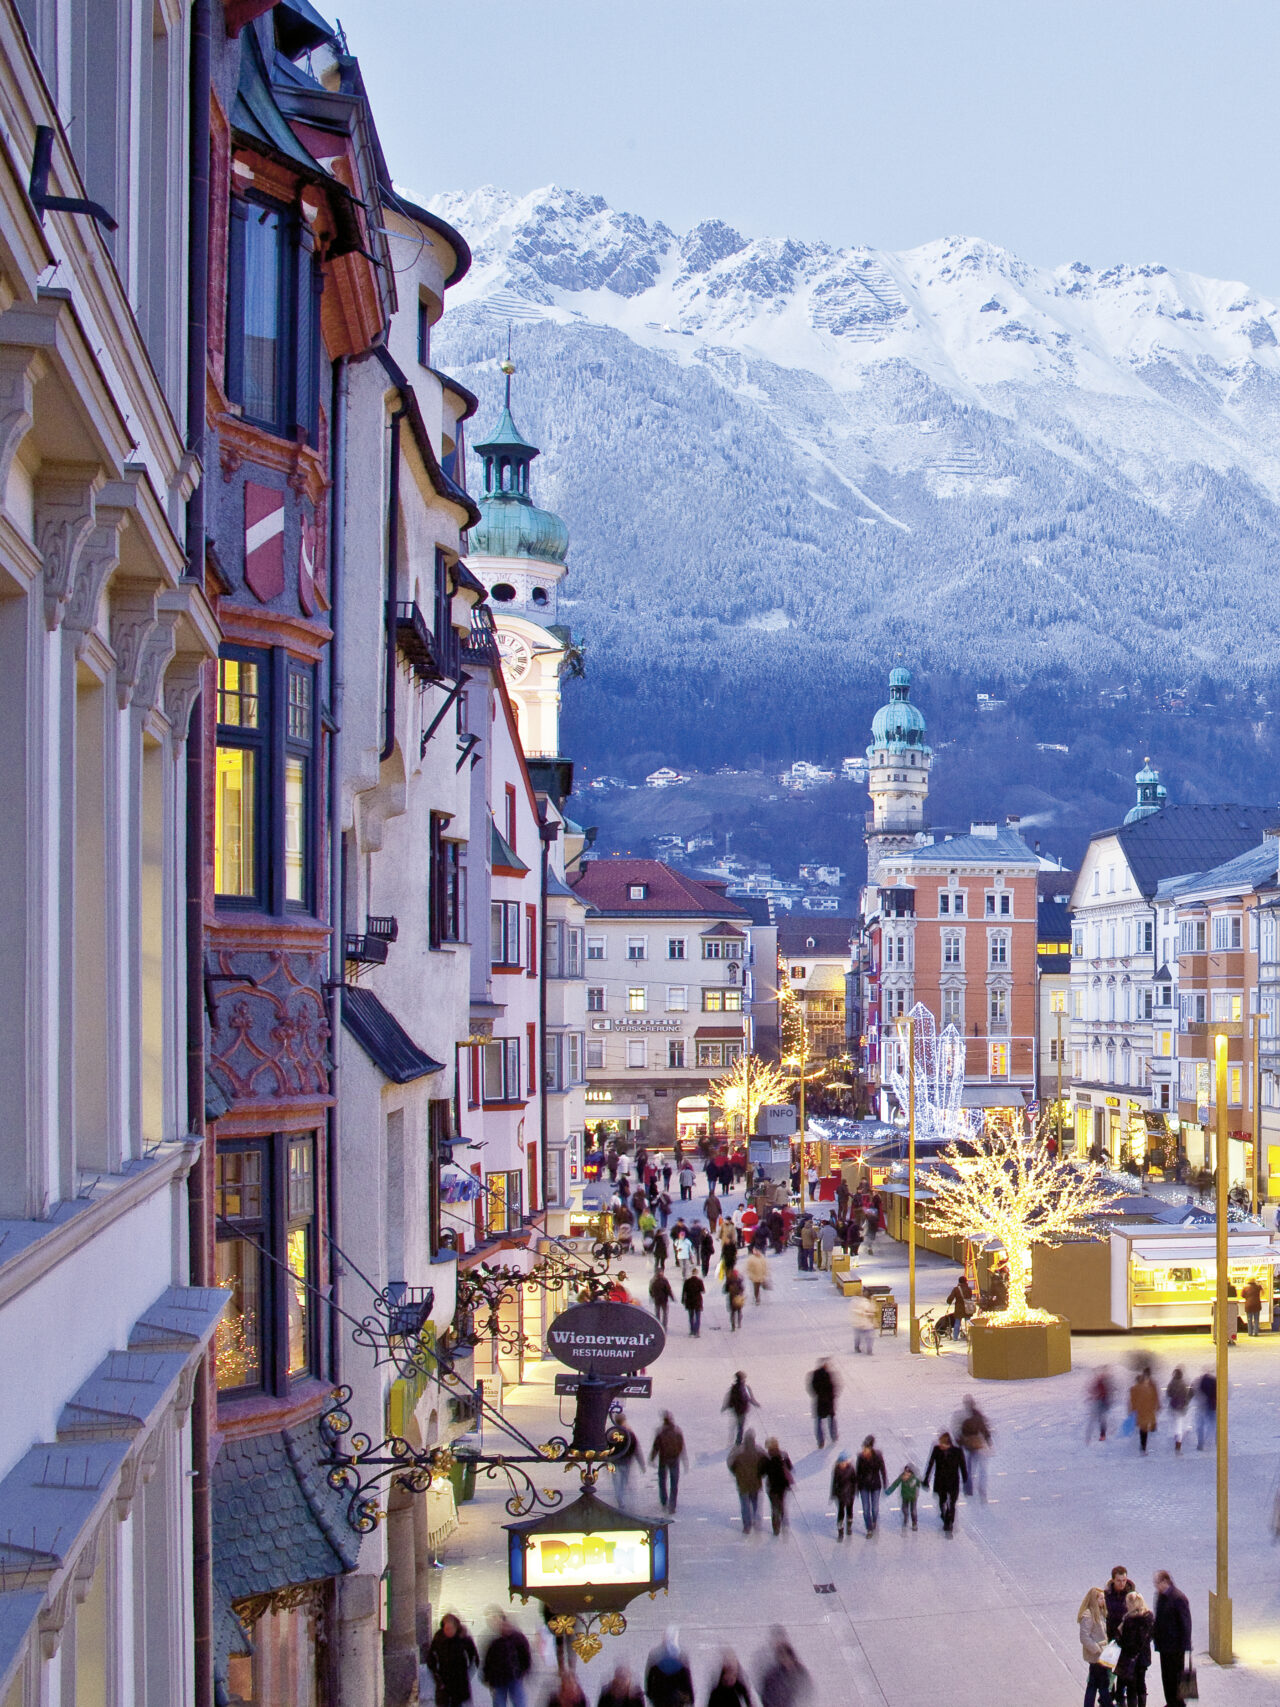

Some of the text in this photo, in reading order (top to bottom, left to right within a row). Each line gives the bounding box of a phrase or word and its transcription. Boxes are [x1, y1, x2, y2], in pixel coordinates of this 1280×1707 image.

[614, 1017, 682, 1025] donau
[769, 1109, 794, 1117] INFO
[572, 1348, 636, 1358] RESTAURANT
